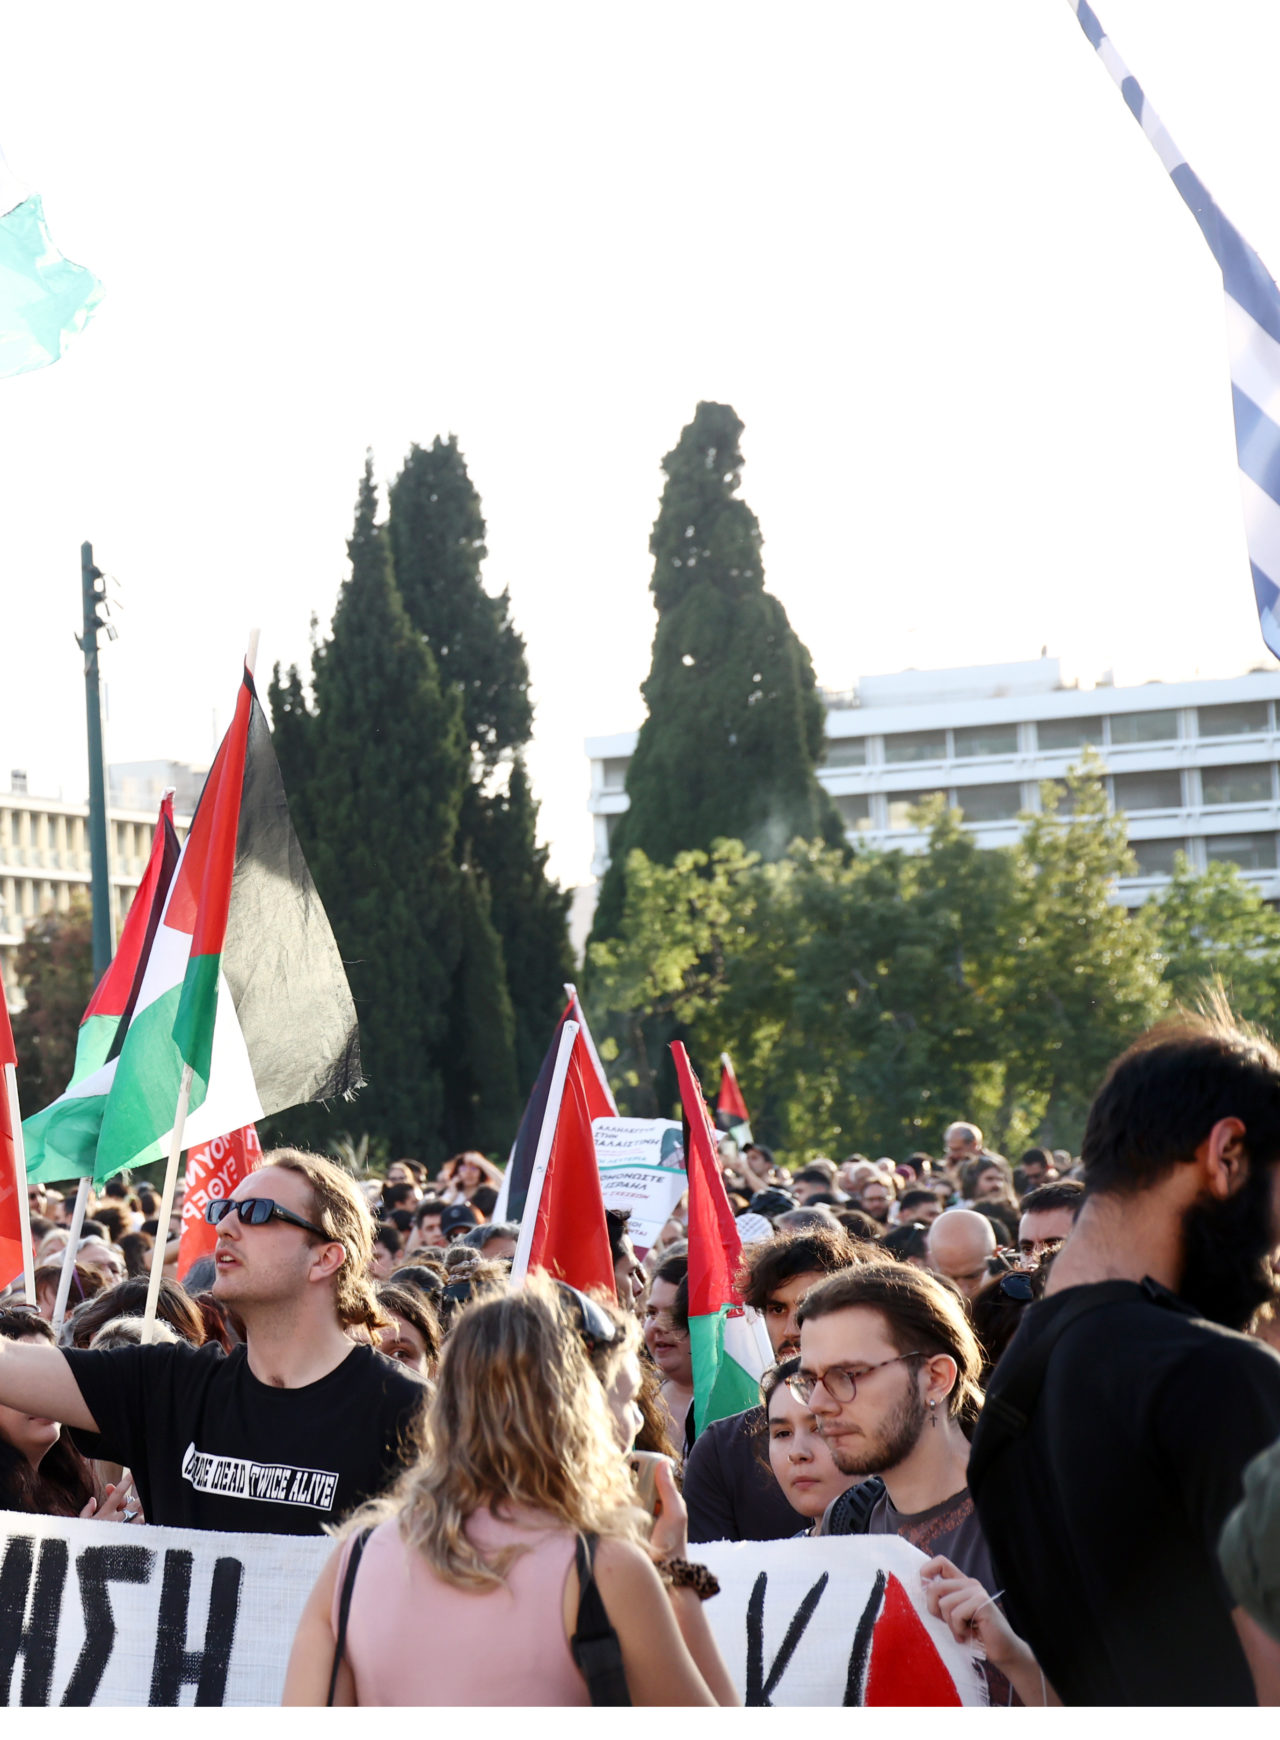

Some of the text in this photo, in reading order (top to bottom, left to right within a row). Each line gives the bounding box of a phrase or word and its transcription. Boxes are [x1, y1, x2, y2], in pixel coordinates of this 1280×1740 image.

[211, 1461, 245, 1493] DEAD
[251, 1465, 291, 1500] TWICE
[289, 1471, 335, 1507] ALIVE
